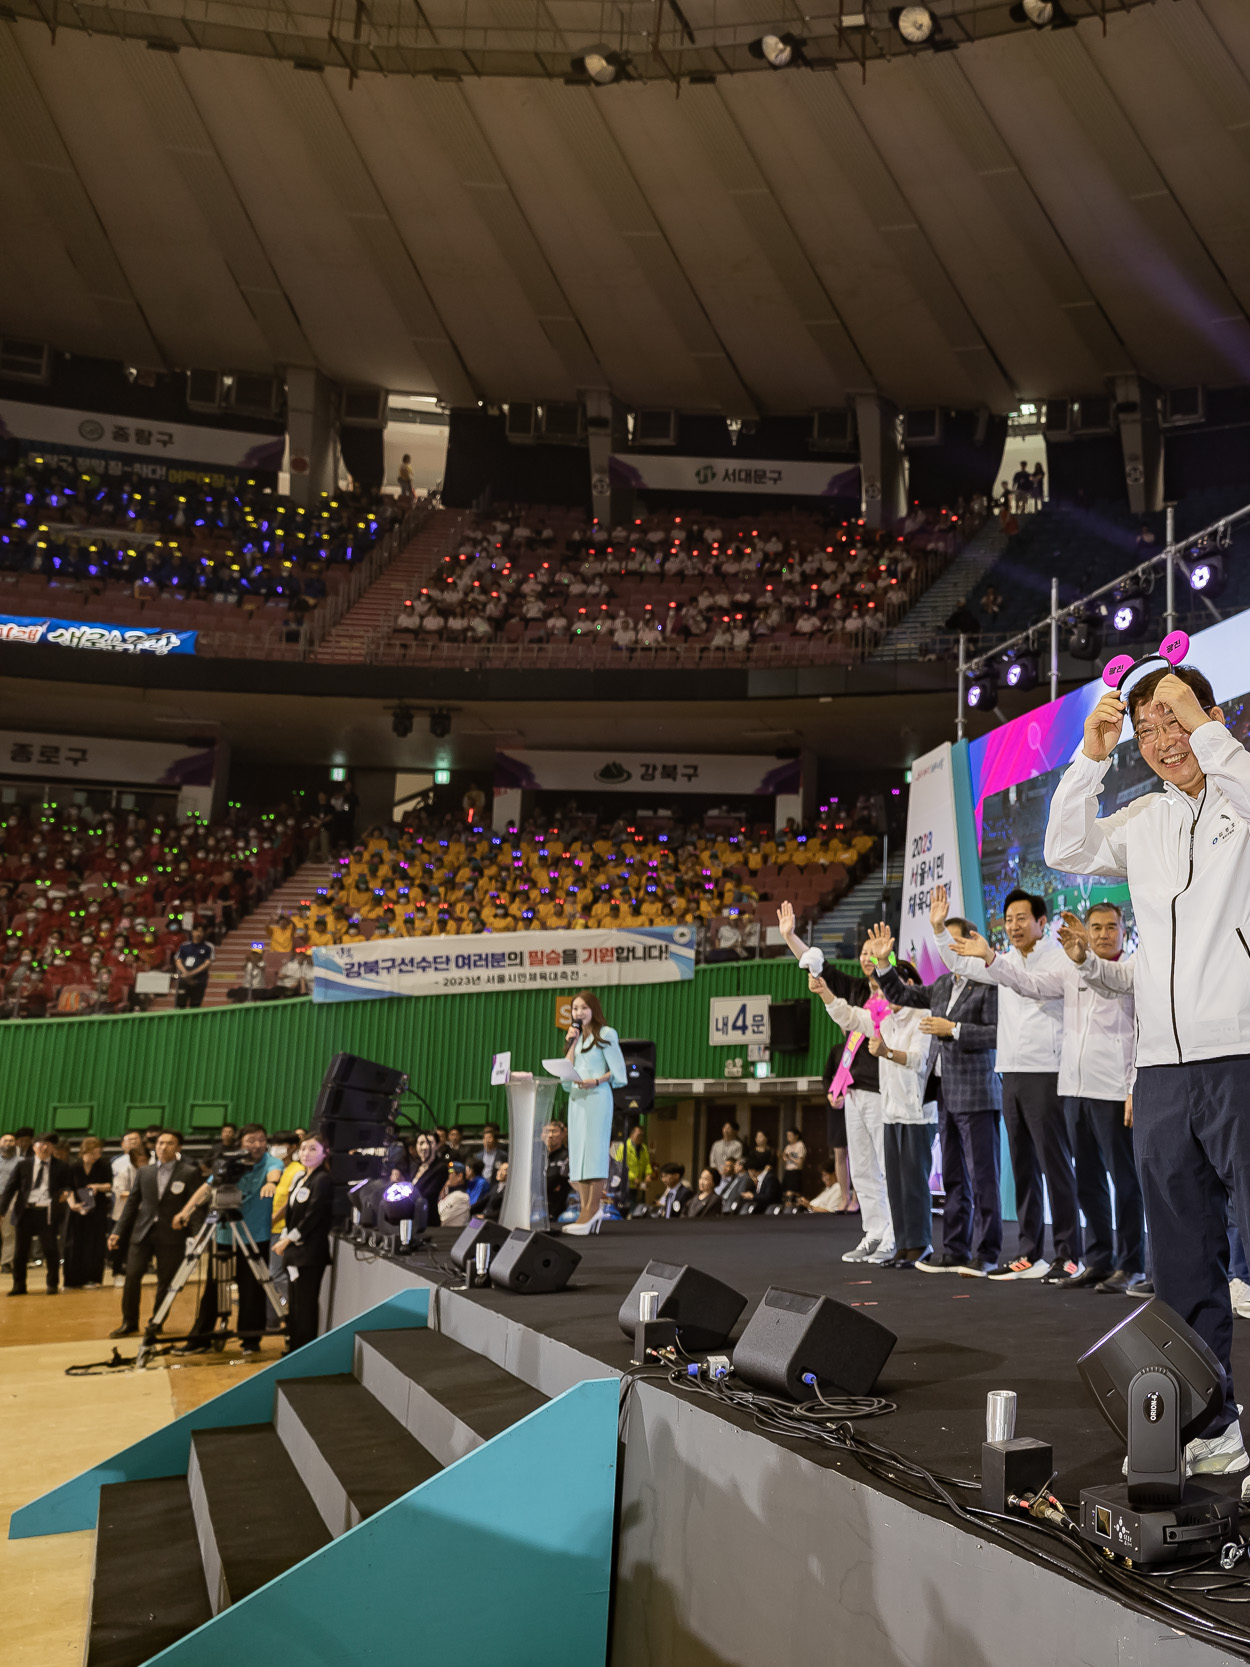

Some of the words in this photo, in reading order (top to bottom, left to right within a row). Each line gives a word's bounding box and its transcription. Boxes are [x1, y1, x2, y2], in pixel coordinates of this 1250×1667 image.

[112, 425, 174, 448] 중랑구
[722, 468, 783, 484] 서대문구
[1166, 639, 1181, 653] 광진
[1109, 664, 1124, 675] 광진
[10, 742, 88, 767] 종로구
[640, 763, 699, 782] 강북구
[912, 831, 933, 858] 2023
[910, 853, 944, 888] 서울시민
[344, 955, 451, 979] 강북구선수단
[455, 950, 523, 970] 여러분의
[528, 948, 577, 967] 필승을
[582, 944, 670, 964] 기원합니다!
[442, 975, 482, 987] 2023년
[1150, 1394, 1158, 1421] ORION-6
